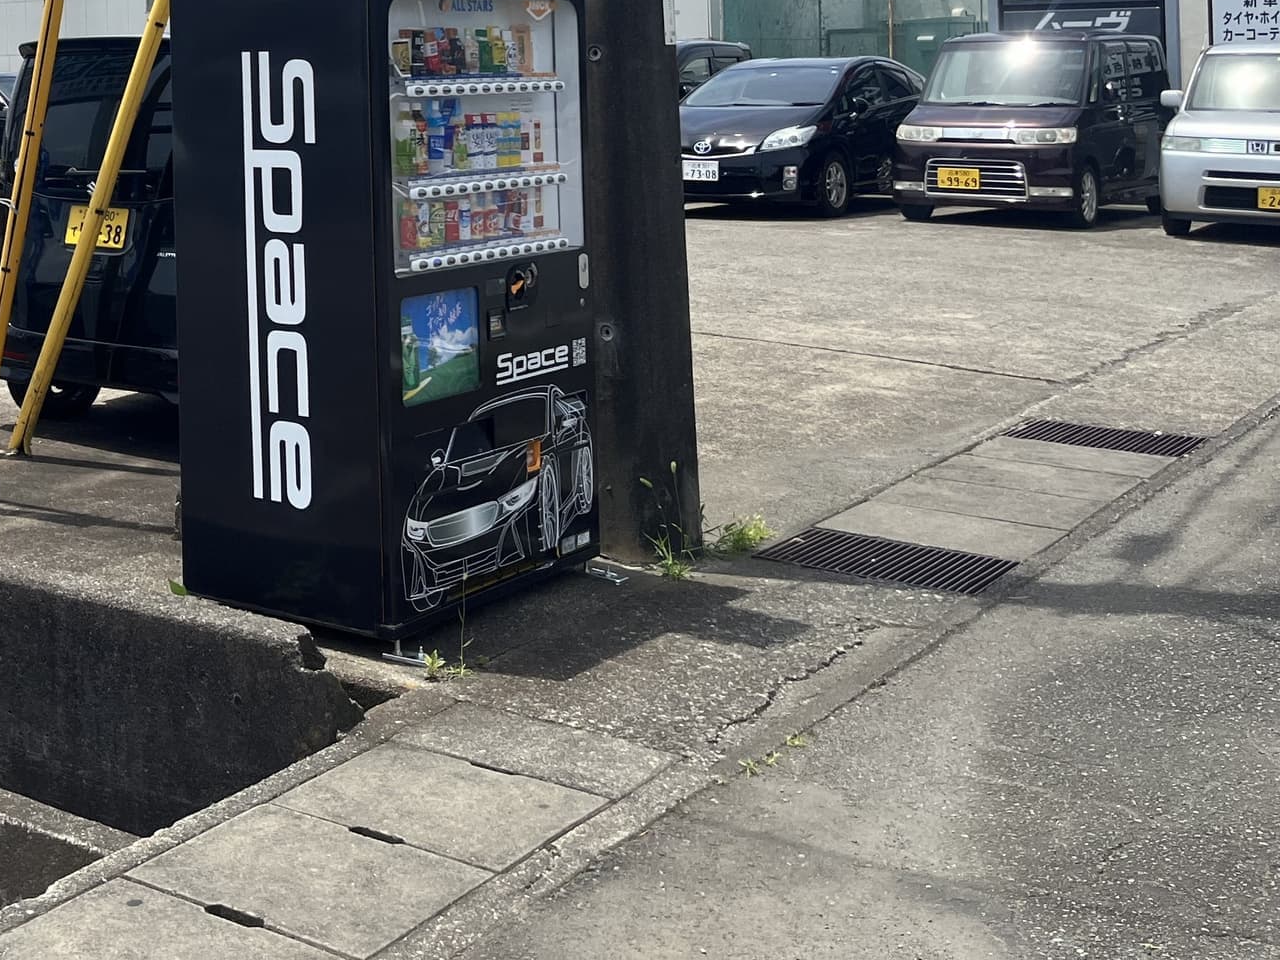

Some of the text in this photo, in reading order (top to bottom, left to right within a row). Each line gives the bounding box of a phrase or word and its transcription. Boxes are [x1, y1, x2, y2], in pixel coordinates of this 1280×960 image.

[452, 0, 493, 12] ALL STARS
[946, 176, 978, 187] 99-69
[244, 51, 317, 511] Space
[496, 345, 569, 382] Space
